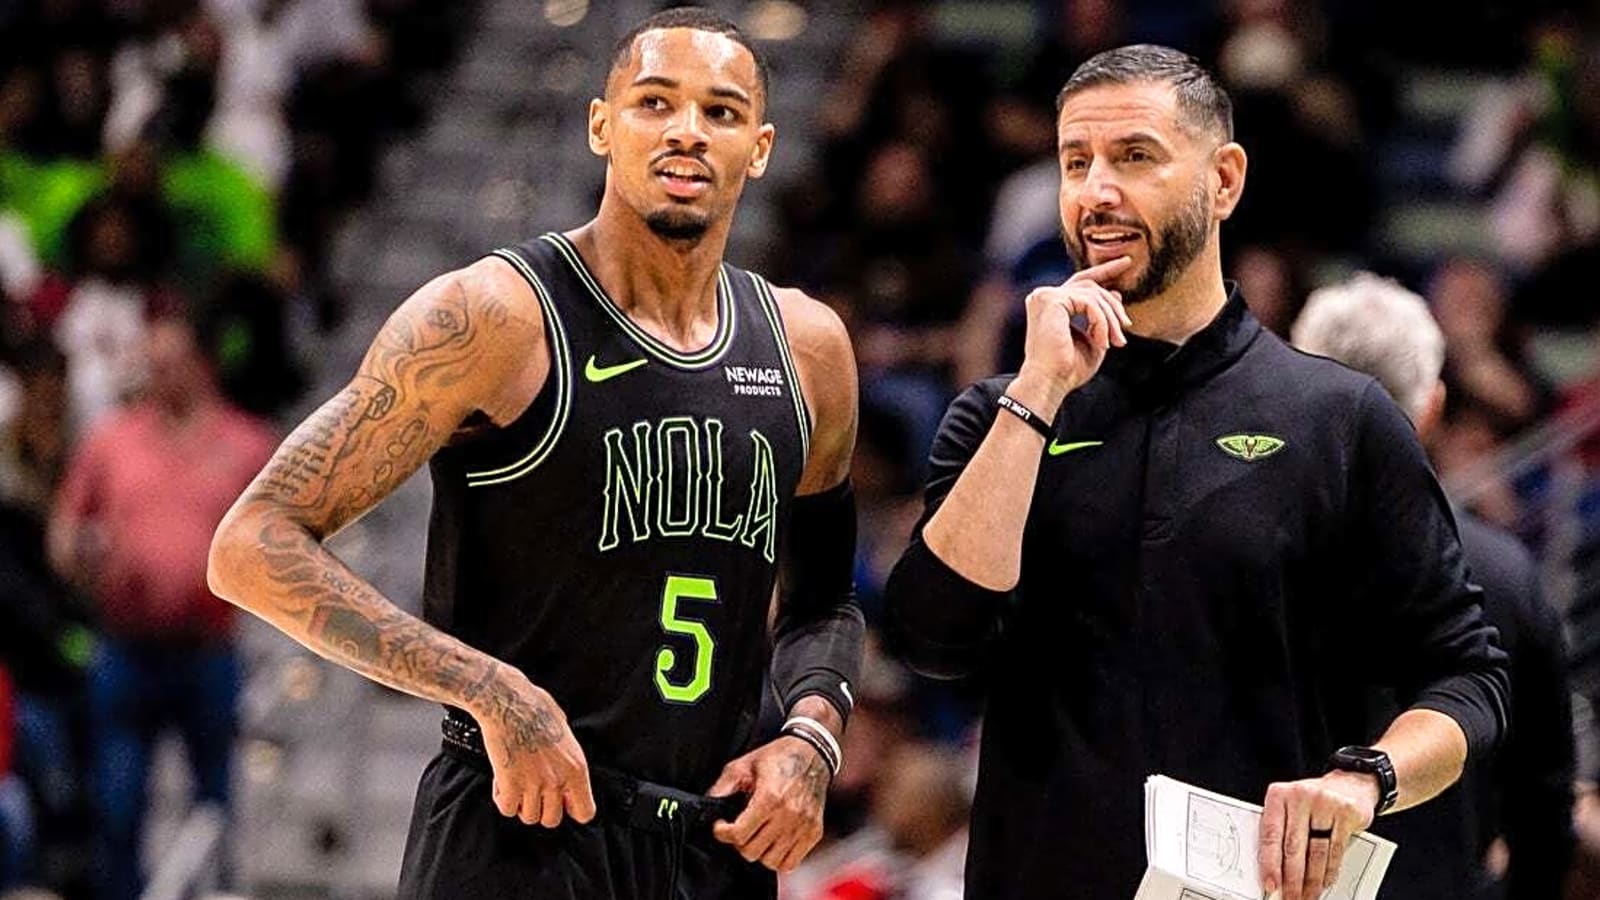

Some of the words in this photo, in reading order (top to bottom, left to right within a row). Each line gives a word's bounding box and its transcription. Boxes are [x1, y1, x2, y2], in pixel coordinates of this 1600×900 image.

[724, 365, 784, 385] NEWAGE
[733, 384, 782, 397] PRODUCTS
[599, 417, 778, 563] NOLA
[655, 574, 719, 703] 5
